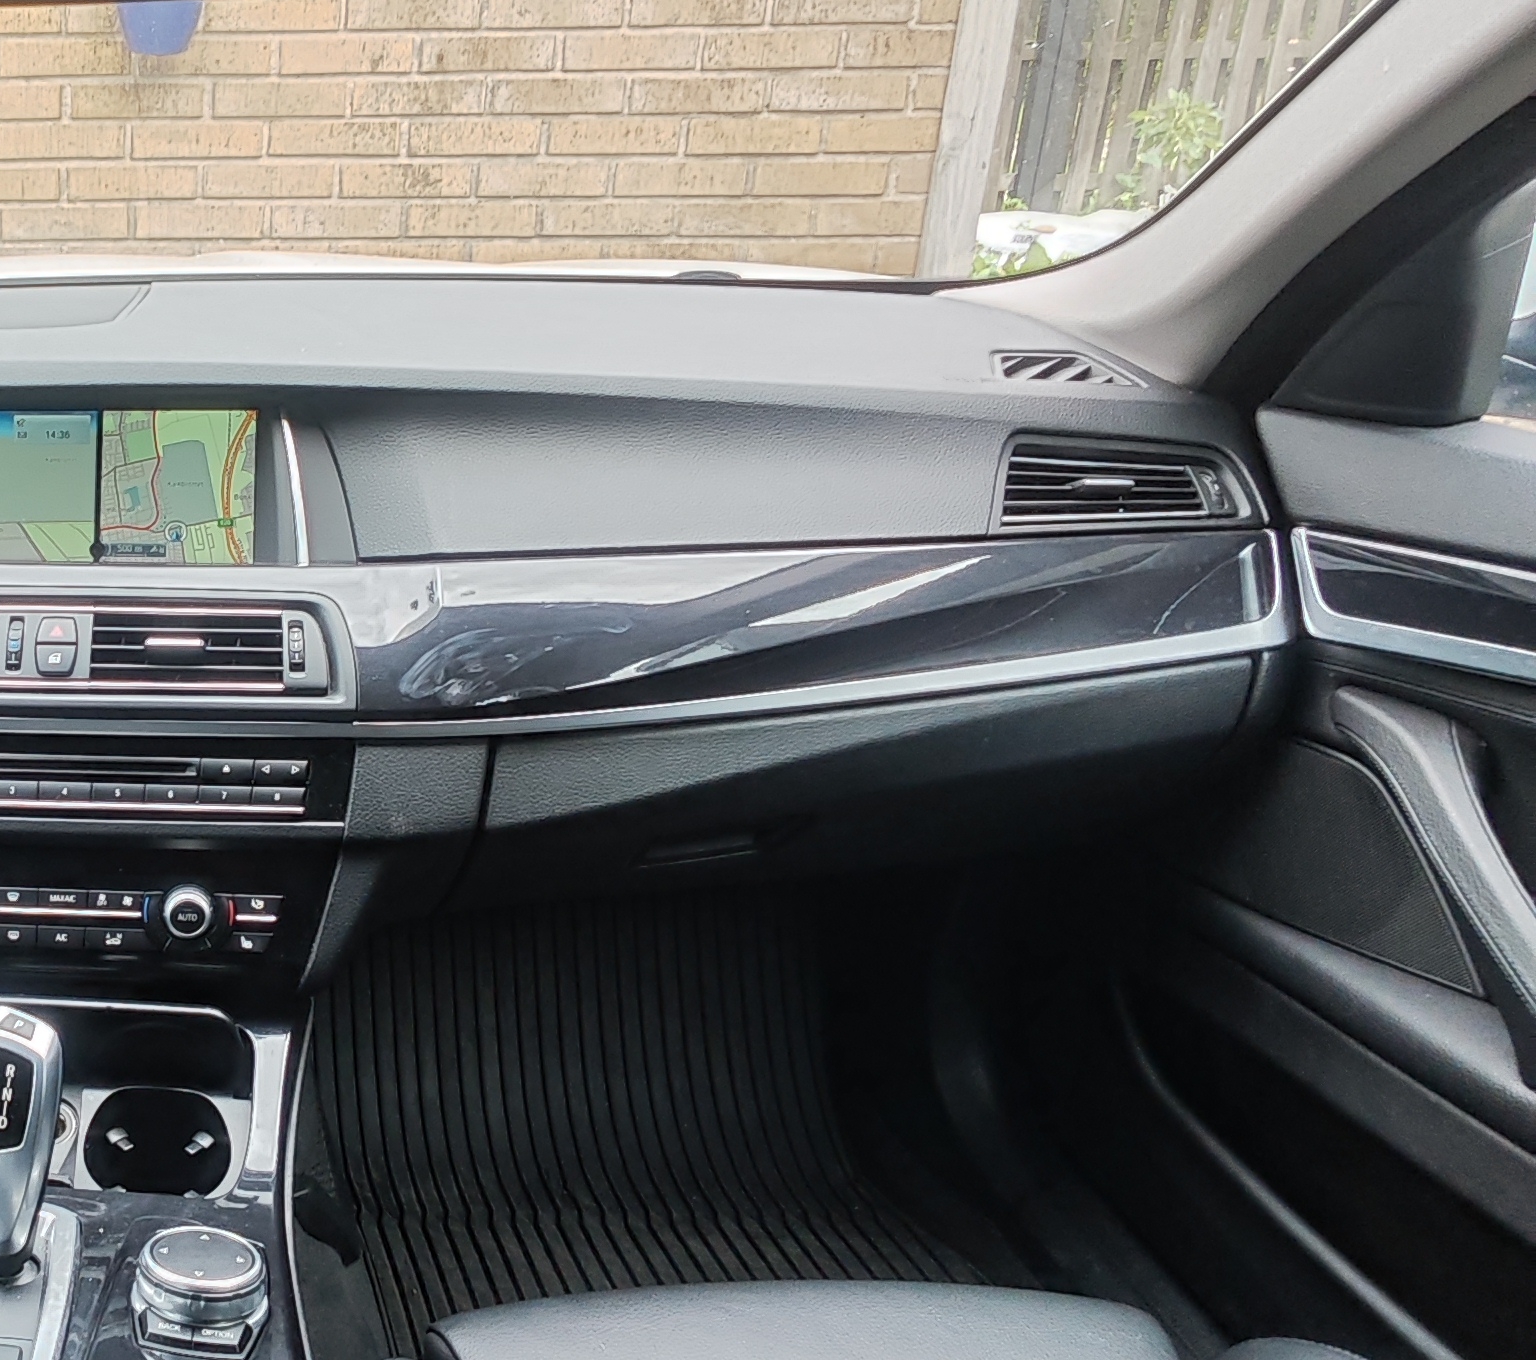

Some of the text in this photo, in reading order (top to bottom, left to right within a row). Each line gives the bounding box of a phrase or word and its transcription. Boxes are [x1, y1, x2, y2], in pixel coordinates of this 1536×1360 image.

[45, 430, 71, 439] 14:36
[9, 785, 15, 795] 3
[61, 787, 68, 796] 4
[114, 788, 121, 797] 5
[167, 790, 174, 799] 6
[221, 790, 228, 800] 7
[177, 913, 198, 922] AUTO
[54, 933, 68, 942] AC
[13, 1020, 24, 1029] P
[5, 1063, 16, 1078] R
[1, 1087, 13, 1101] N
[157, 1322, 181, 1331] BACK
[201, 1328, 234, 1339] OPTION
